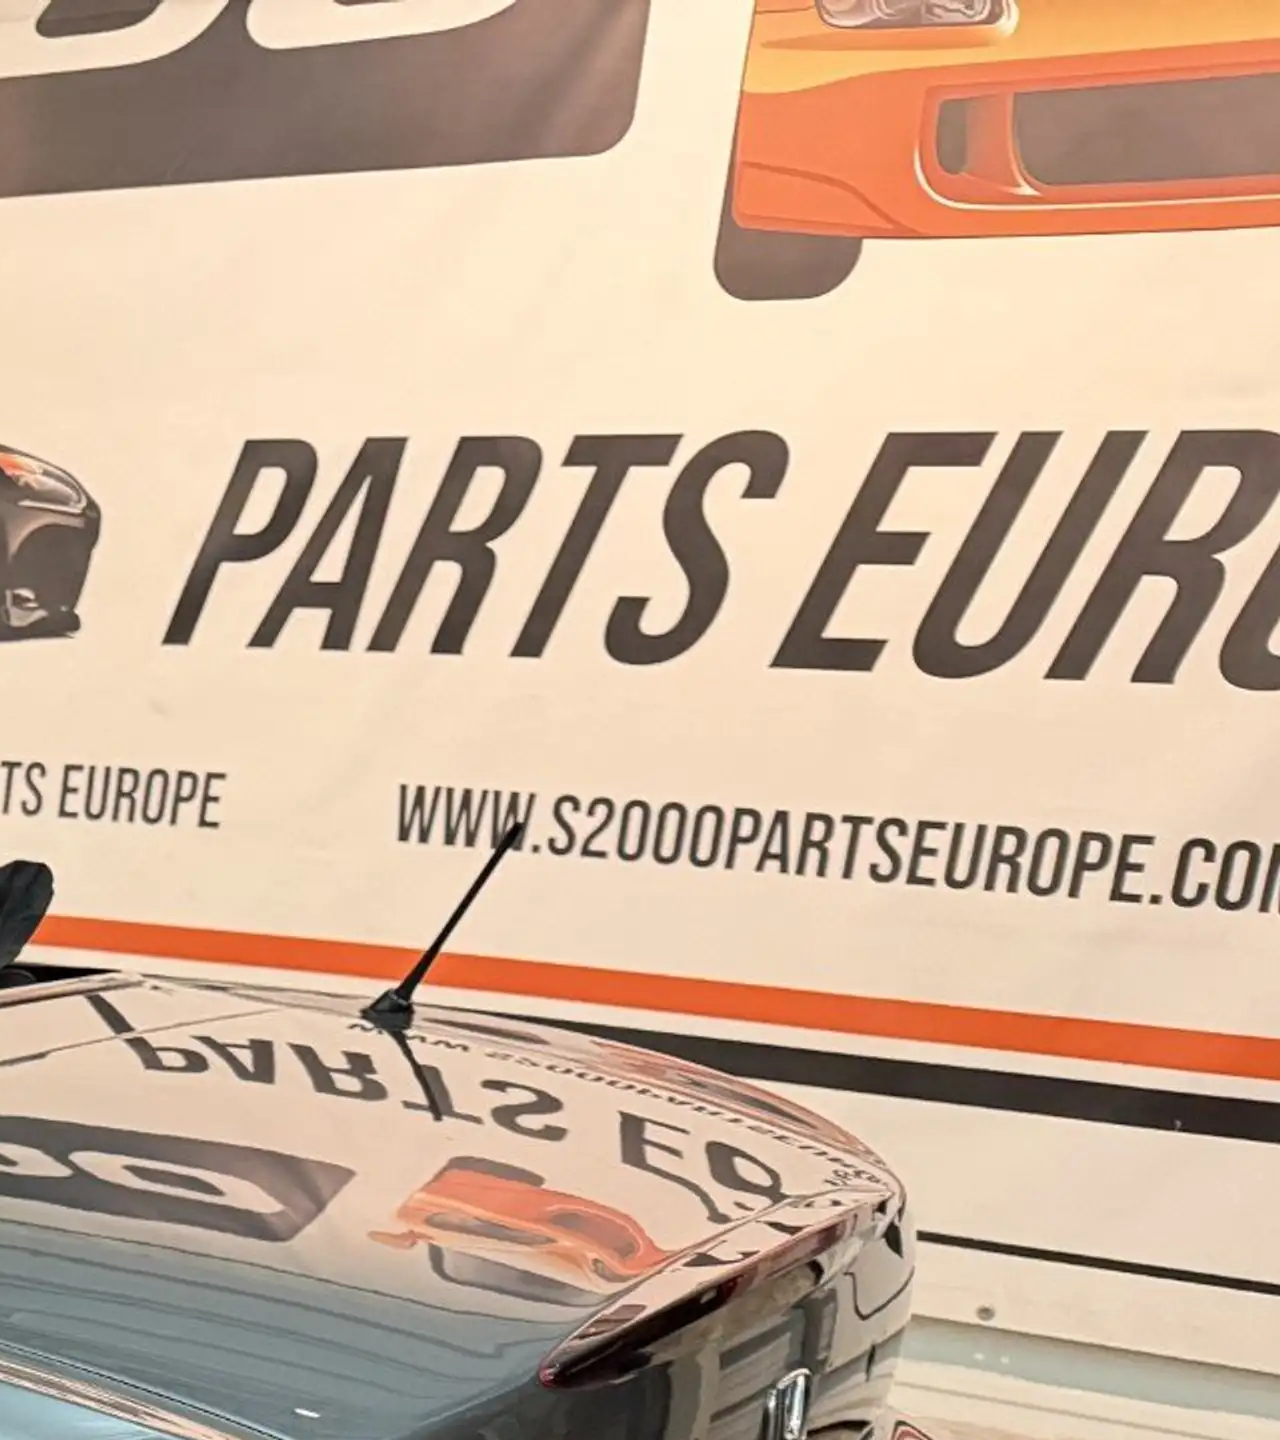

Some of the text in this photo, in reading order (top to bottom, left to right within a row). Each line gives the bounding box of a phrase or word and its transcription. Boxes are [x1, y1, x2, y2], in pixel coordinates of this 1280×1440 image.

[162, 428, 1280, 691] PARTS EUR
[57, 764, 227, 829] EUROPE
